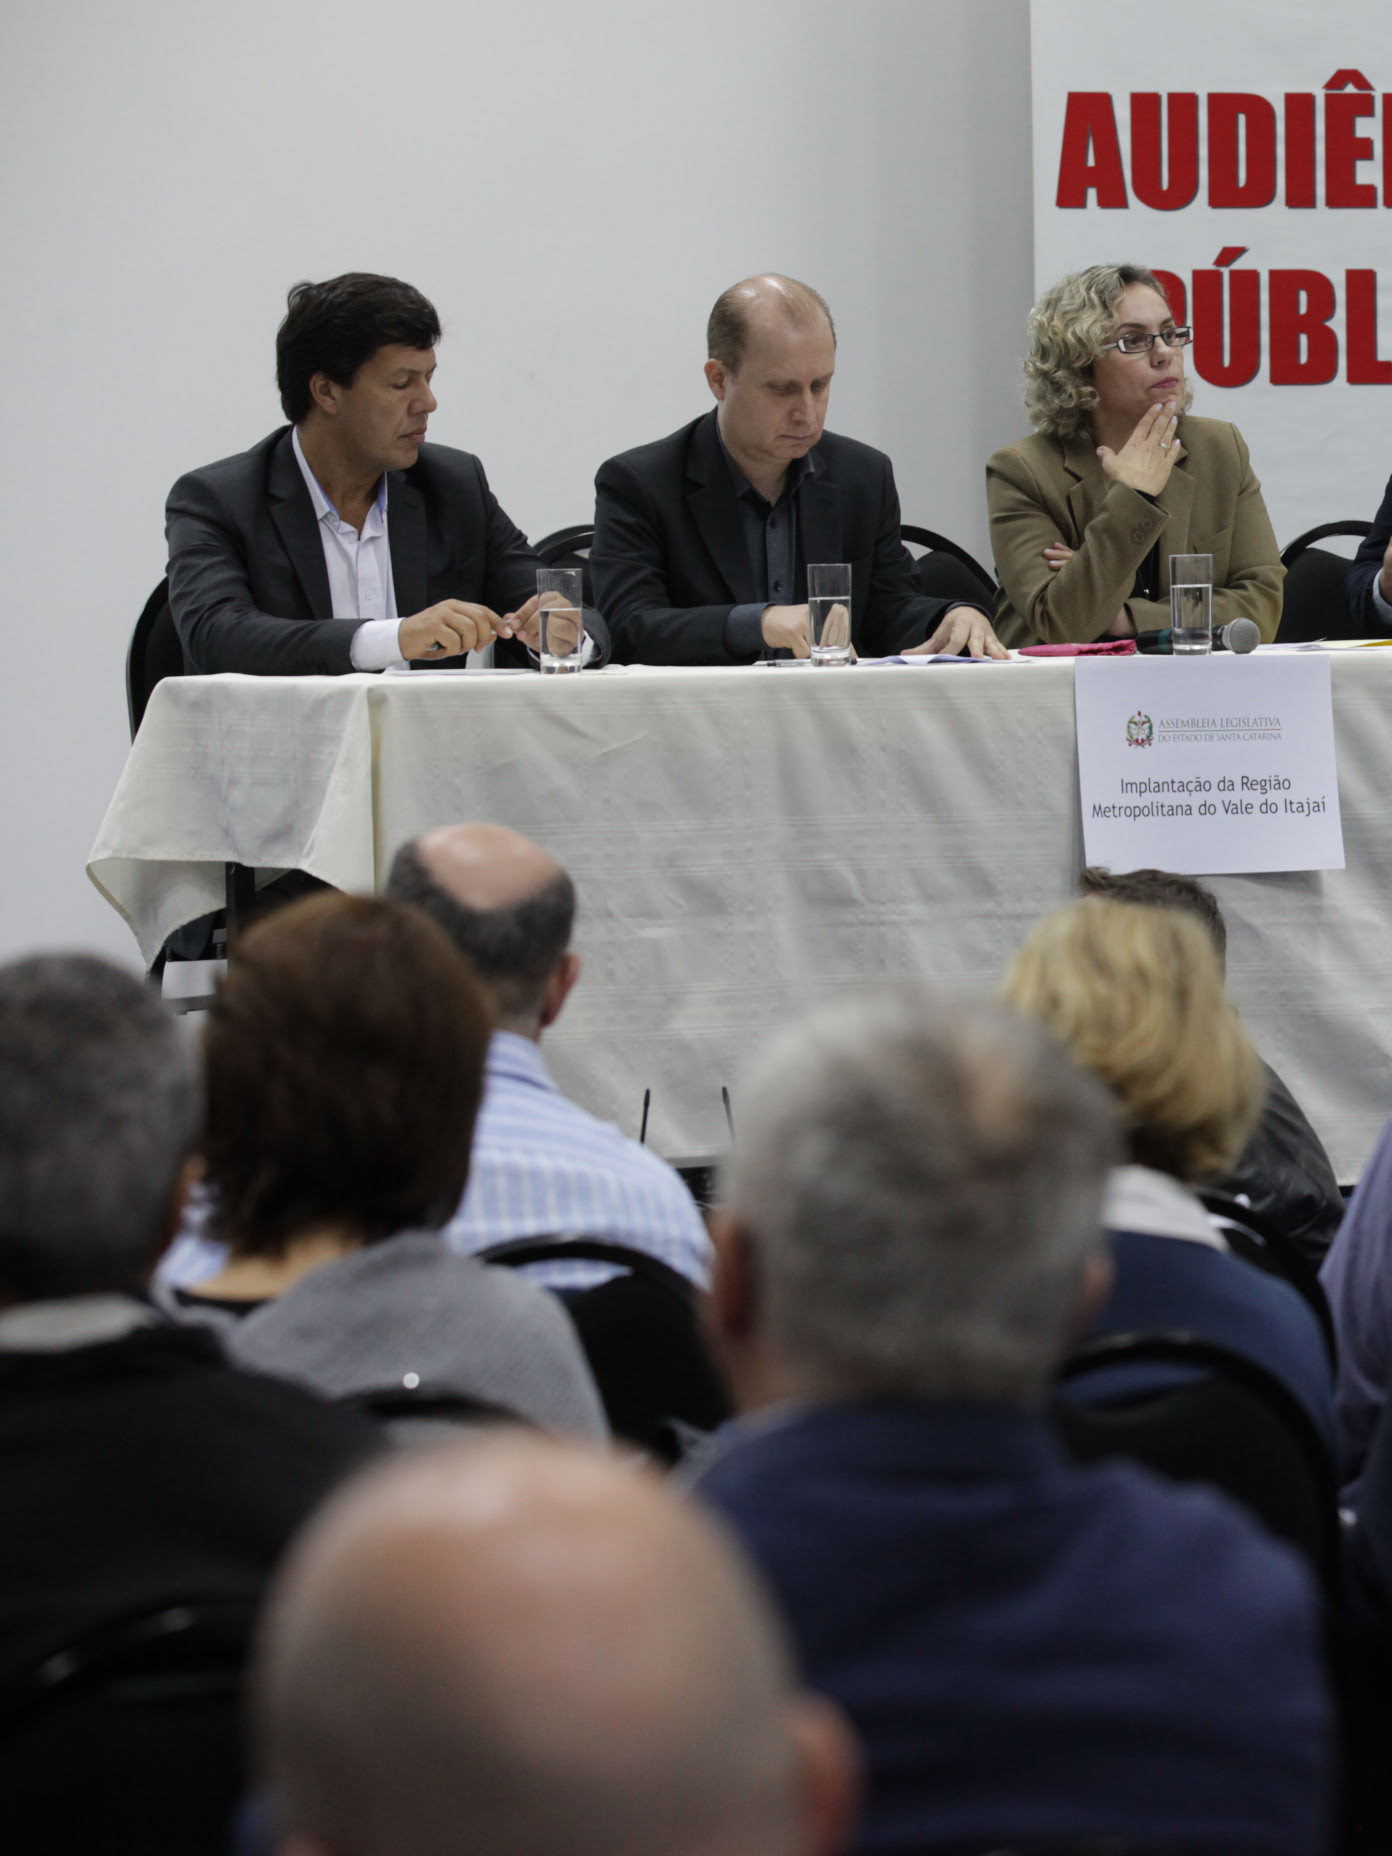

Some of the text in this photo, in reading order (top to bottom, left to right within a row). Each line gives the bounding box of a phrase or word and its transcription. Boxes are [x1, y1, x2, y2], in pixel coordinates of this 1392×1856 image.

[1159, 717, 1281, 729] ASSEMBLEIA LEGISLATIVA
[1158, 732, 1281, 742] DO ESTADO DE SANTA CATARINA
[1121, 775, 1291, 797] Implantação da Região
[1092, 796, 1326, 821] Metropolitana do Vale do Itajaí
